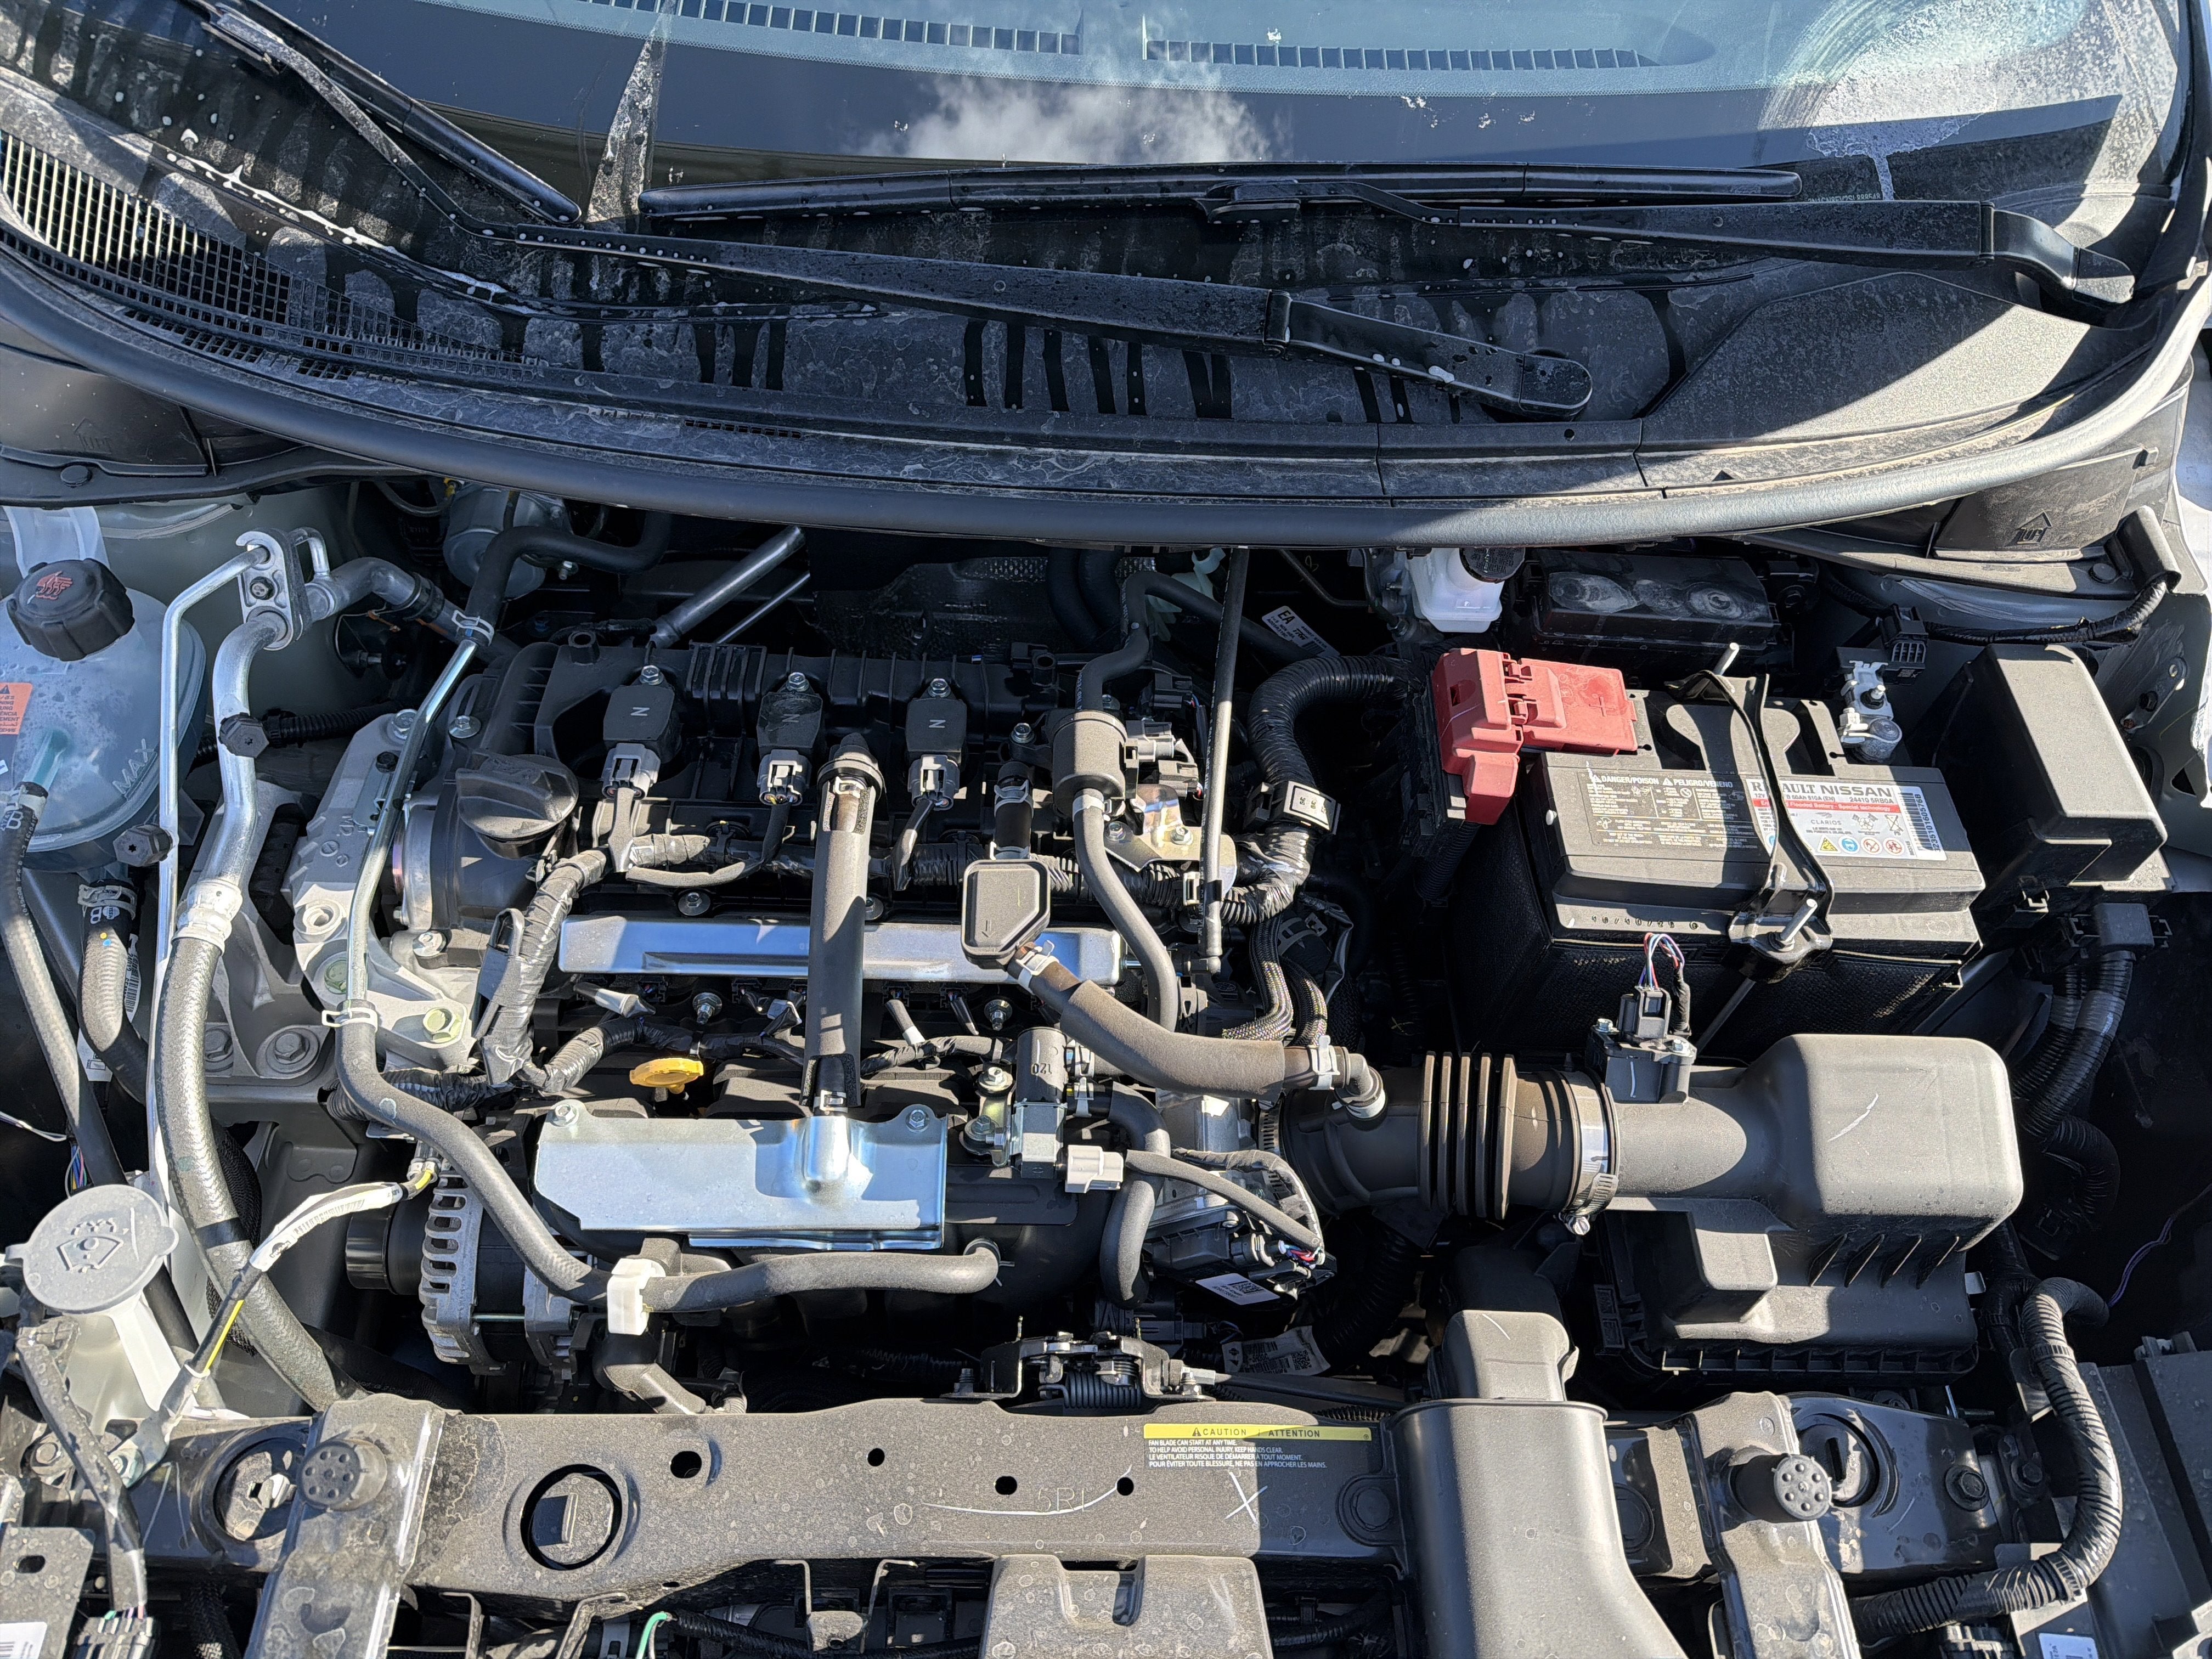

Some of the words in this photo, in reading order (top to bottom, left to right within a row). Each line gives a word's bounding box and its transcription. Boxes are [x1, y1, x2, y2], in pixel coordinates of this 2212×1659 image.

[1278, 610, 1295, 624] EA
[112, 738, 154, 794] MAX
[1601, 776, 1659, 785] DANGER/POISON
[1673, 778, 1733, 788] PELIGRO/VENENO
[1820, 785, 1892, 797] NISSAN
